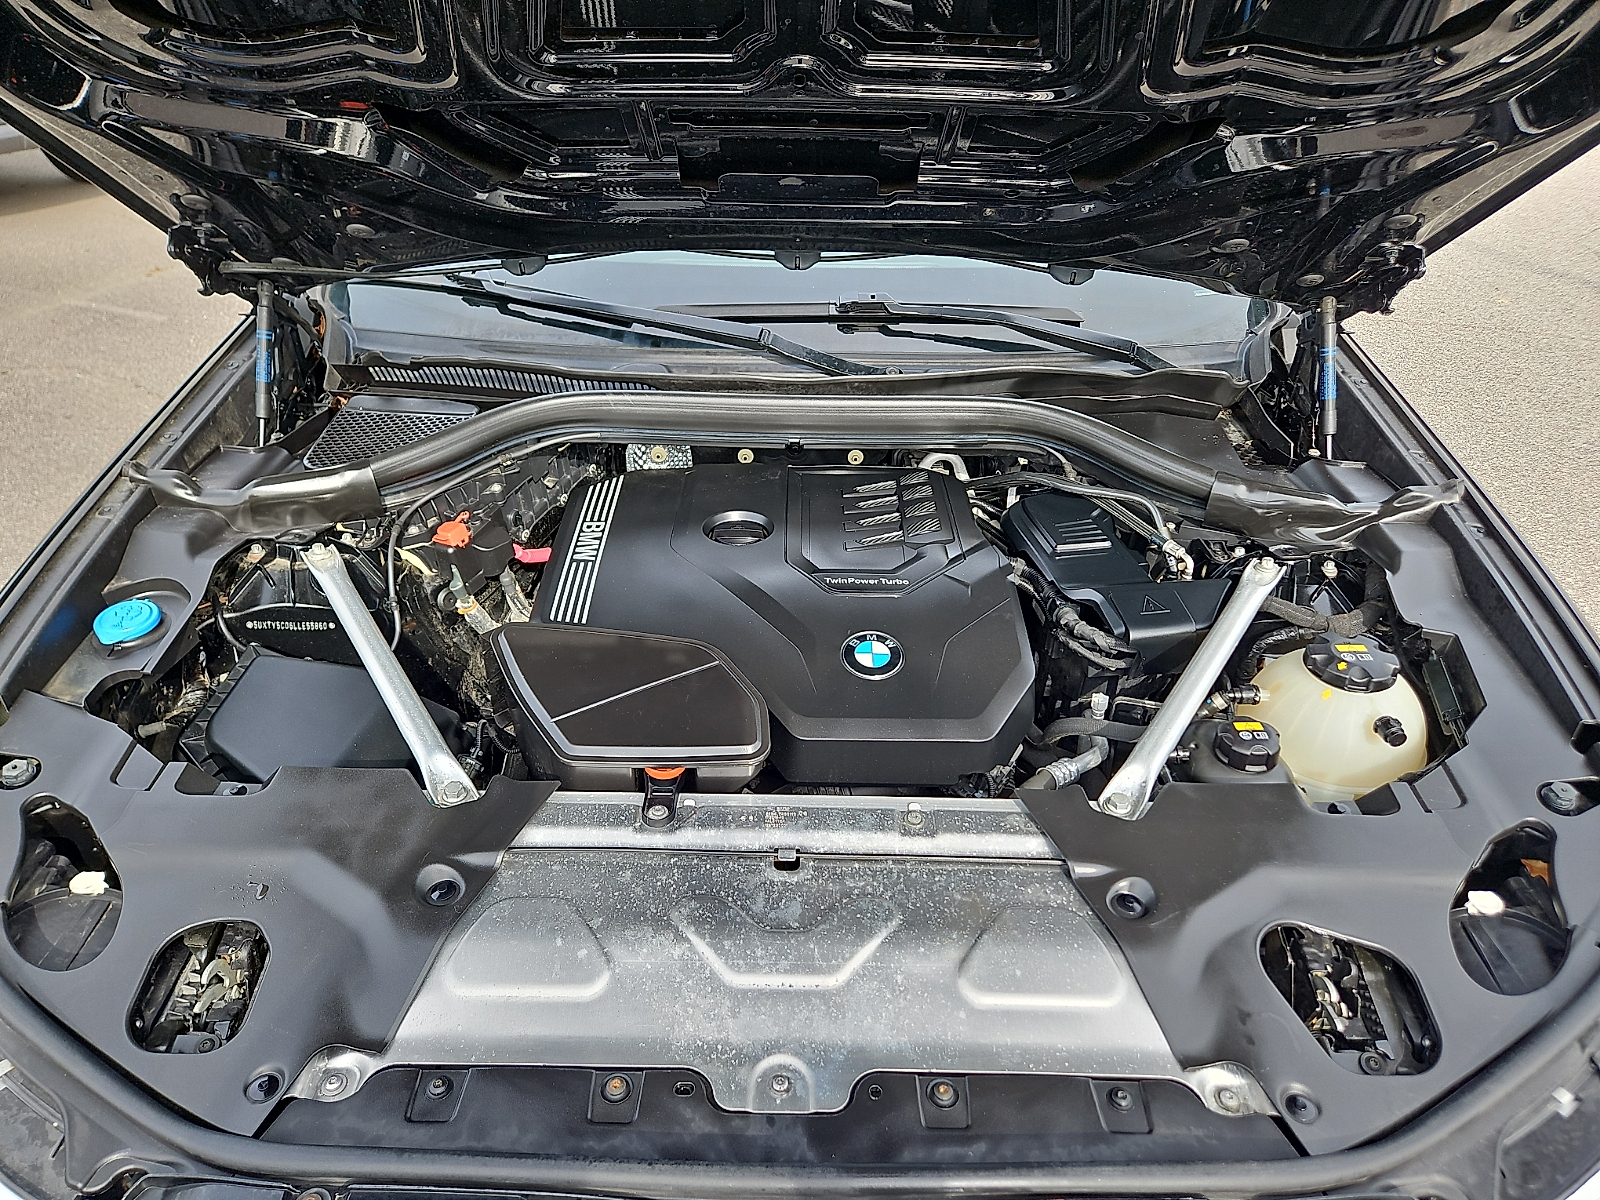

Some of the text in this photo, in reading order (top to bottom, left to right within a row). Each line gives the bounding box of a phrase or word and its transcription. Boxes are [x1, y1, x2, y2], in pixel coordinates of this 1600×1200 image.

[572, 521, 606, 561] BMW
[824, 577, 879, 585] TwinPower
[849, 634, 897, 649] BMW
